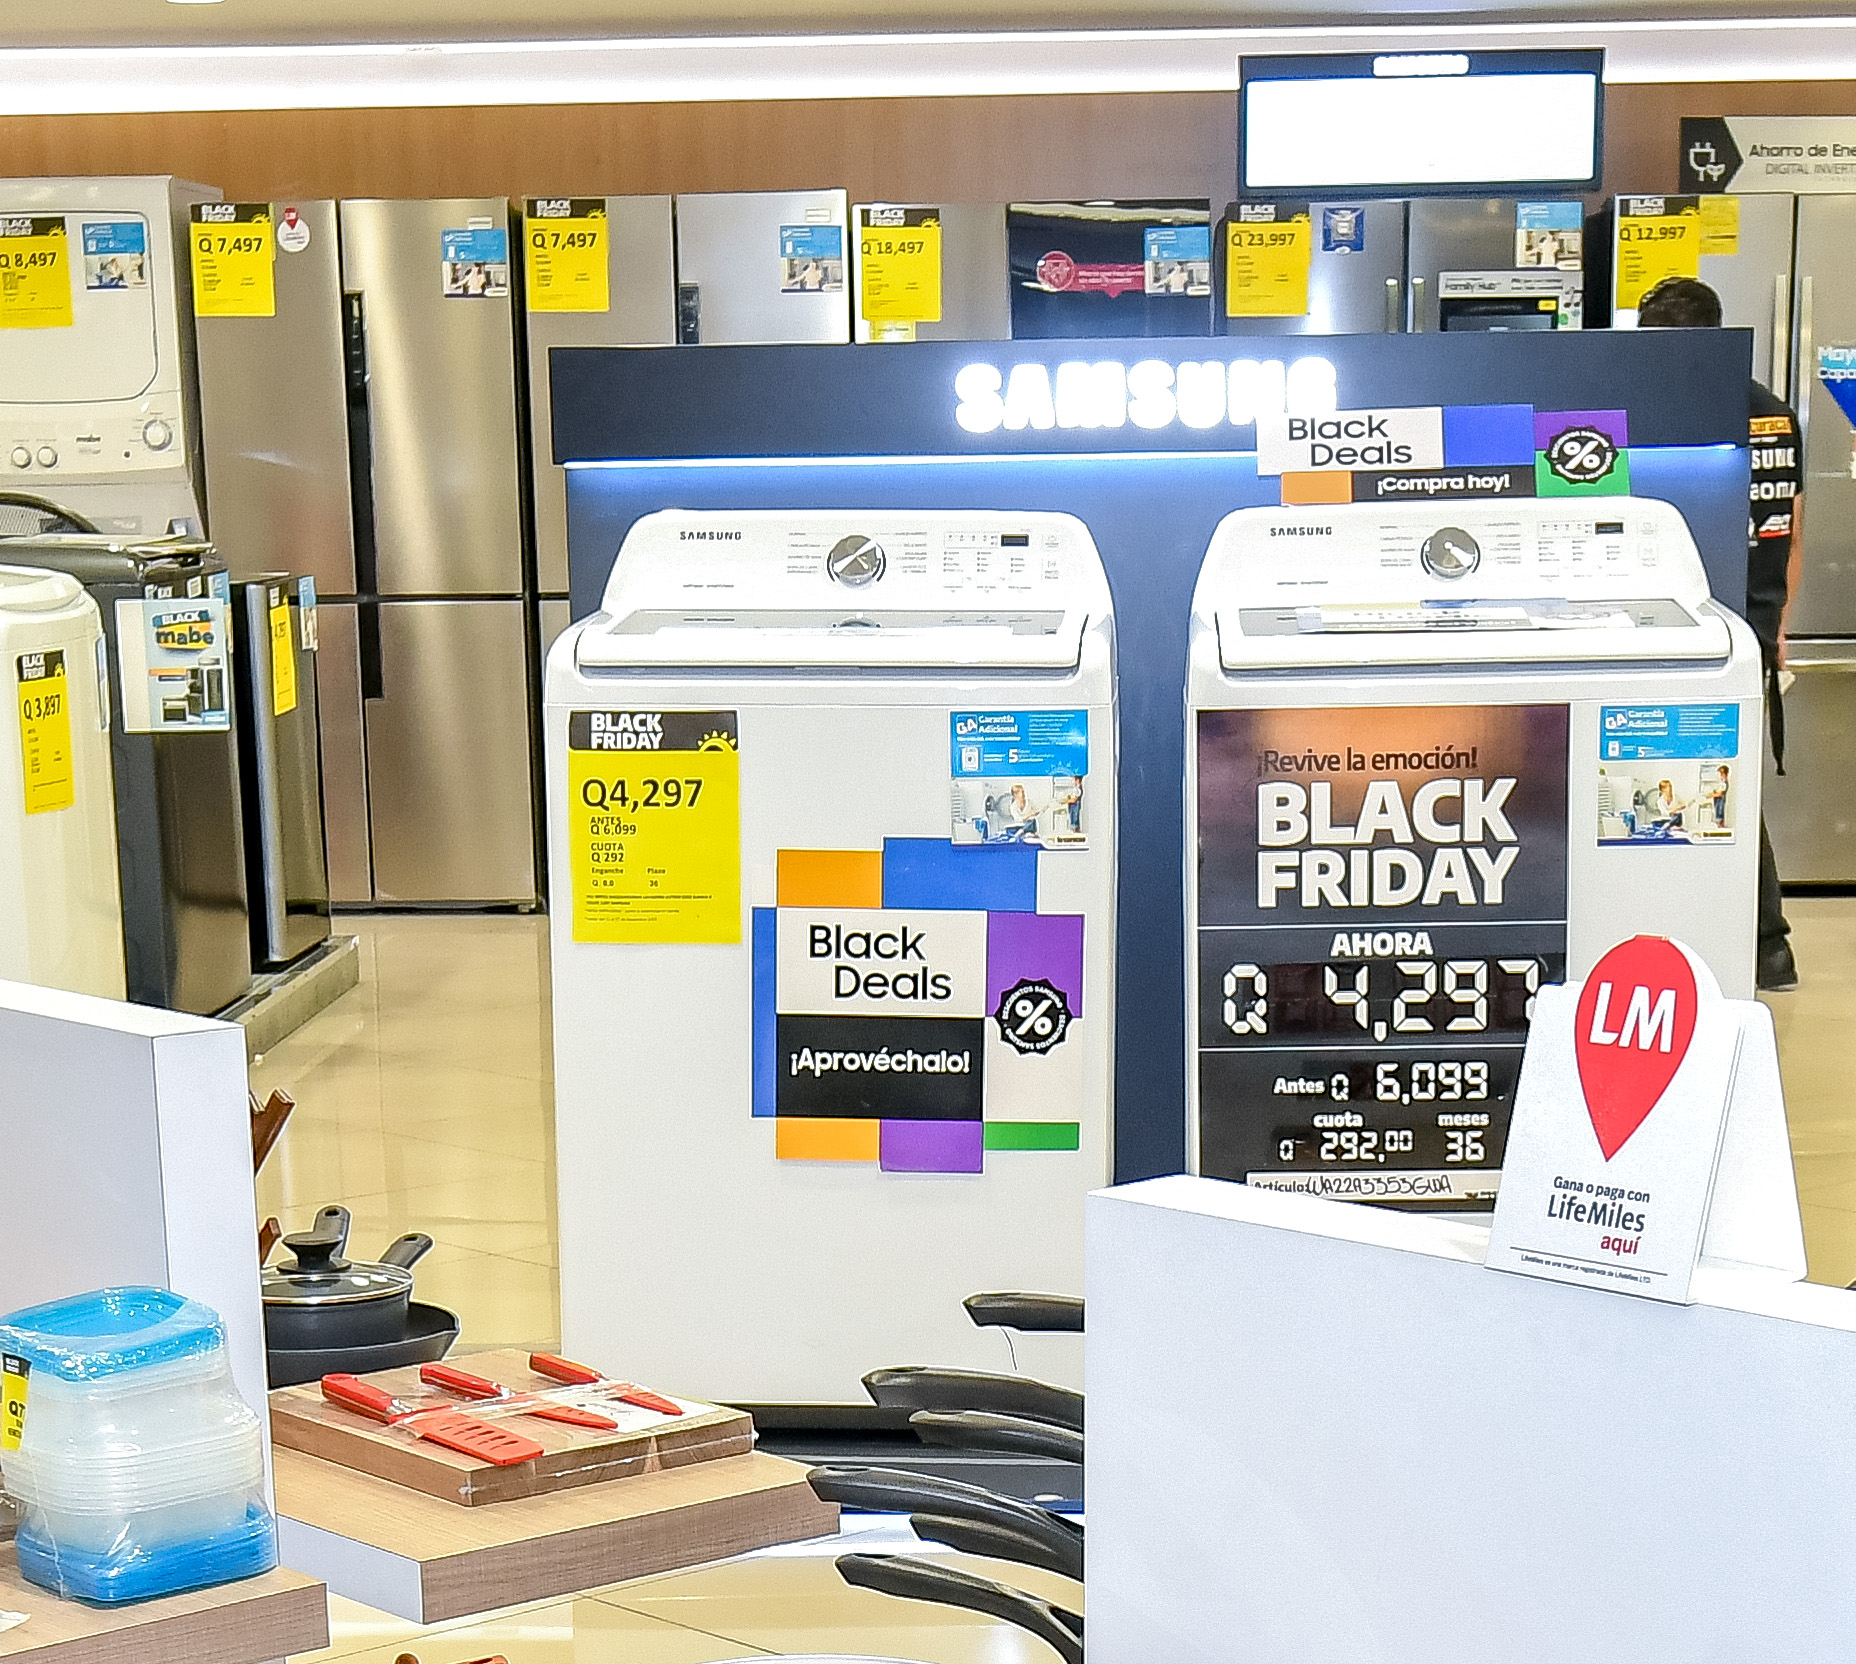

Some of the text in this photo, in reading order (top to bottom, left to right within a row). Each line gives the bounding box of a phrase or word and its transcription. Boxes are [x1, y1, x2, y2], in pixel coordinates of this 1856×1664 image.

[1749, 143, 1803, 158] Ahorro
[1809, 143, 1828, 157] de
[532, 231, 598, 252] Q 7,497
[1231, 231, 1295, 249] Q 23,997
[1620, 225, 1632, 242] Q
[198, 236, 263, 257] Q 7,497
[861, 240, 924, 257] Q 18,497
[15, 251, 57, 270] 8,497
[1288, 415, 1389, 443] Black
[1310, 441, 1413, 467] Deals
[1377, 472, 1511, 497] ¡Compra hoy!
[680, 530, 742, 541] SAMSUNG
[1270, 526, 1333, 537] SAMSUNG
[156, 626, 215, 646] mabe
[24, 694, 62, 720] Q 3,897
[591, 712, 663, 732] BLACK
[590, 731, 664, 750] FRIDAY
[1258, 745, 1478, 777] ¡Revive la emoción!
[582, 778, 704, 813] Q4,297
[1257, 778, 1519, 846] BLACK
[590, 824, 637, 836] Q 6,099
[590, 842, 624, 851] CUOTA
[591, 852, 624, 864] Q 292
[1256, 846, 1521, 909] FRIDAY
[808, 924, 927, 960] Black
[1330, 932, 1434, 957] AHORA
[834, 964, 952, 1000] Deals
[1222, 957, 1541, 1042] Q 4,297
[1588, 980, 1677, 1054] LM
[790, 1047, 970, 1078] ¡Aprovéchalo!
[1273, 1076, 1325, 1097] Antes
[1375, 1062, 1490, 1106] 6,099
[1312, 1111, 1490, 1129] cuota meses
[1445, 1130, 1486, 1162] 36
[1553, 1175, 1651, 1203] Gana o paga con
[1546, 1193, 1646, 1233] LifeMiles
[1600, 1234, 1640, 1256] aquí
